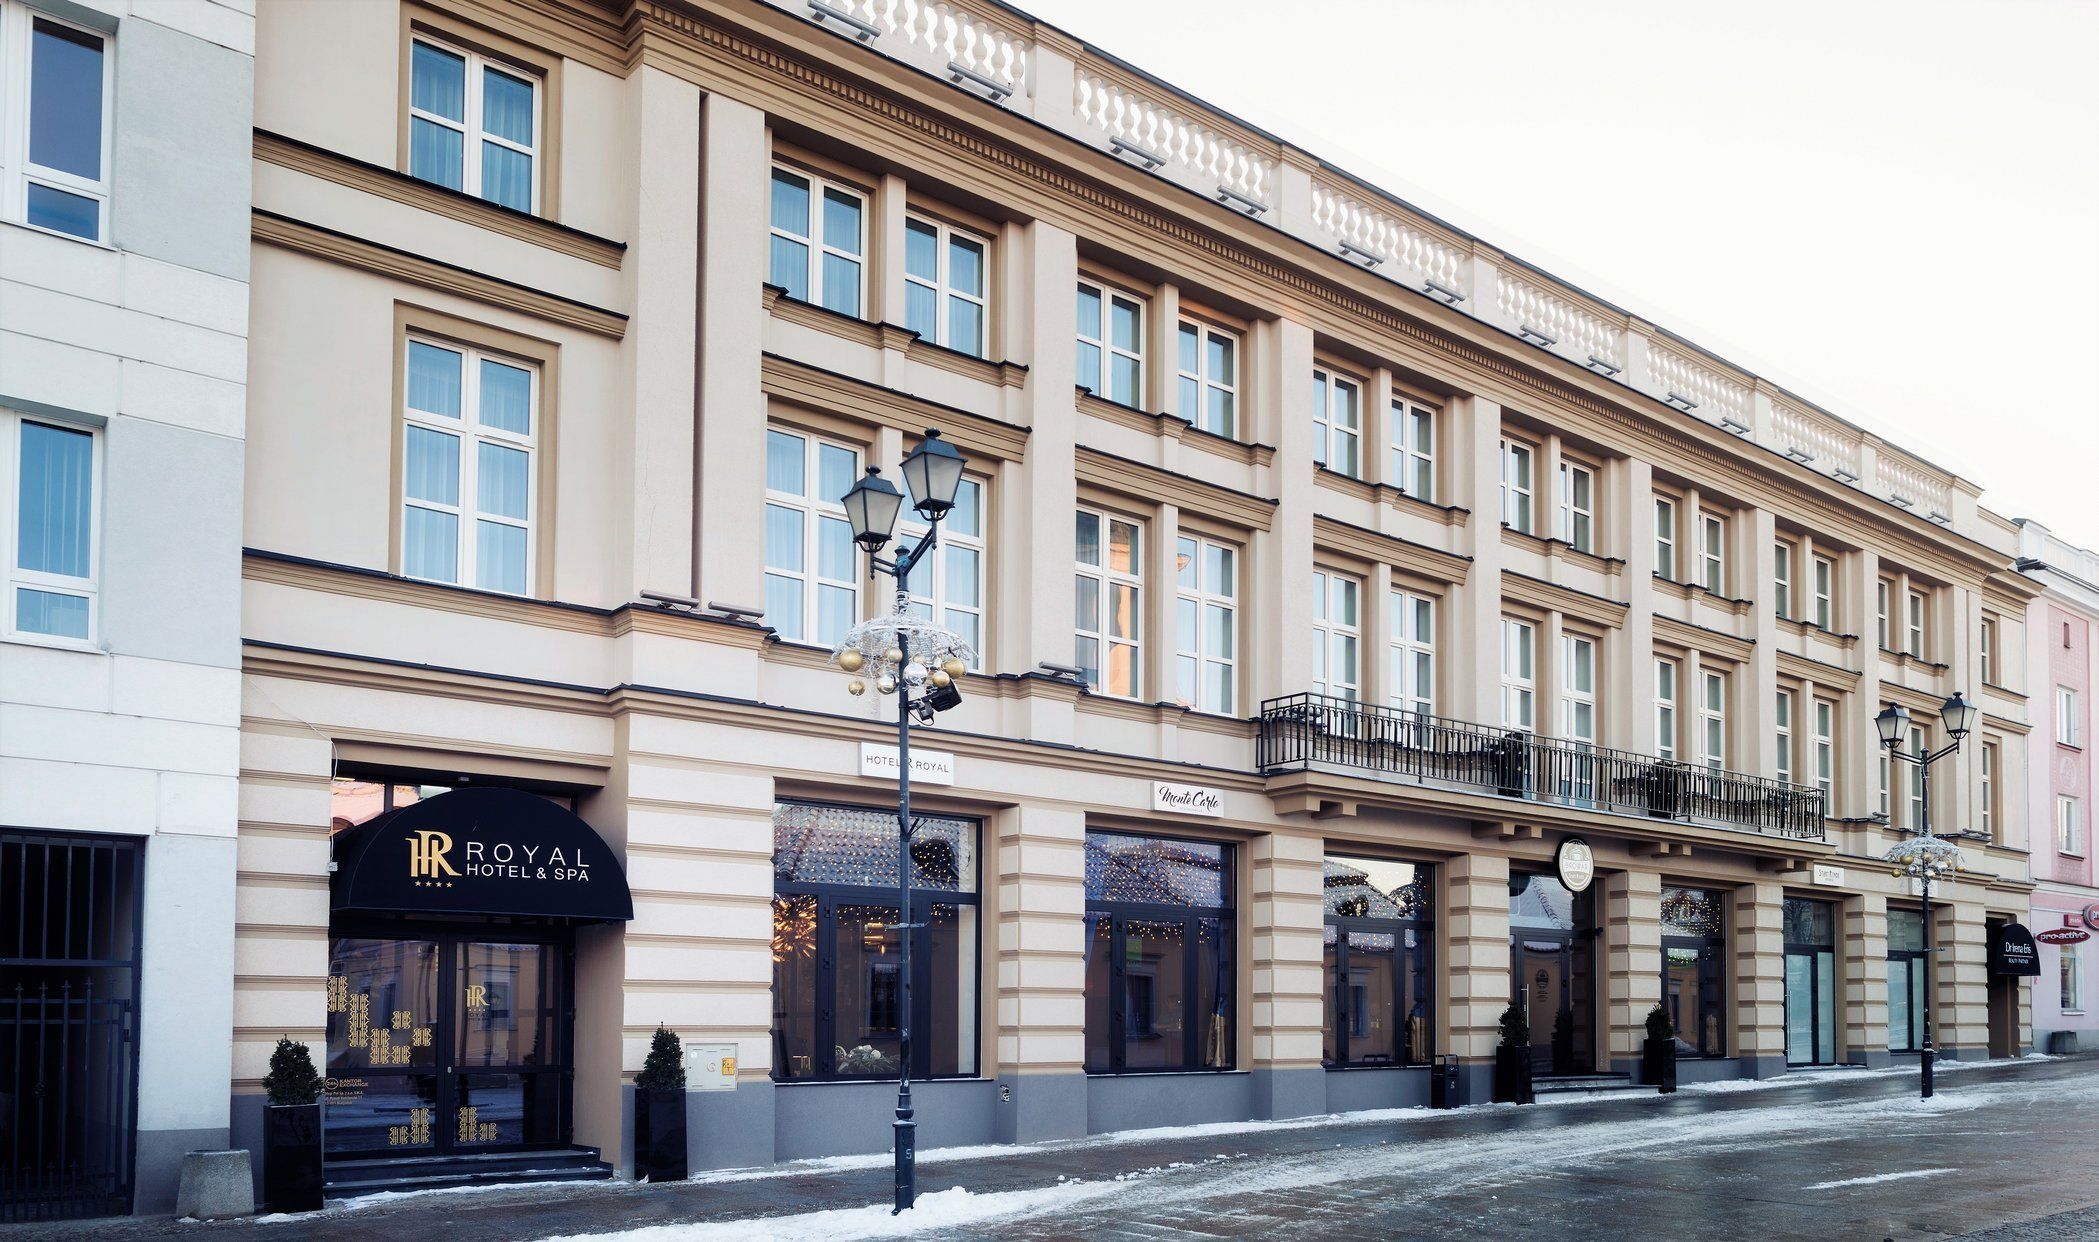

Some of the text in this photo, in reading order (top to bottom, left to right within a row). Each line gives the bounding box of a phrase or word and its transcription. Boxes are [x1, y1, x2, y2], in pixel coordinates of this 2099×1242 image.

[866, 755, 900, 767] HOTEL
[915, 760, 949, 773] ROYAL
[1159, 786, 1220, 812] Monte Carlo
[466, 841, 590, 868] ROYAL
[466, 863, 589, 882] HOTEL & SPA
[2005, 942, 2011, 952] Dr
[2012, 943, 2023, 953] Irena
